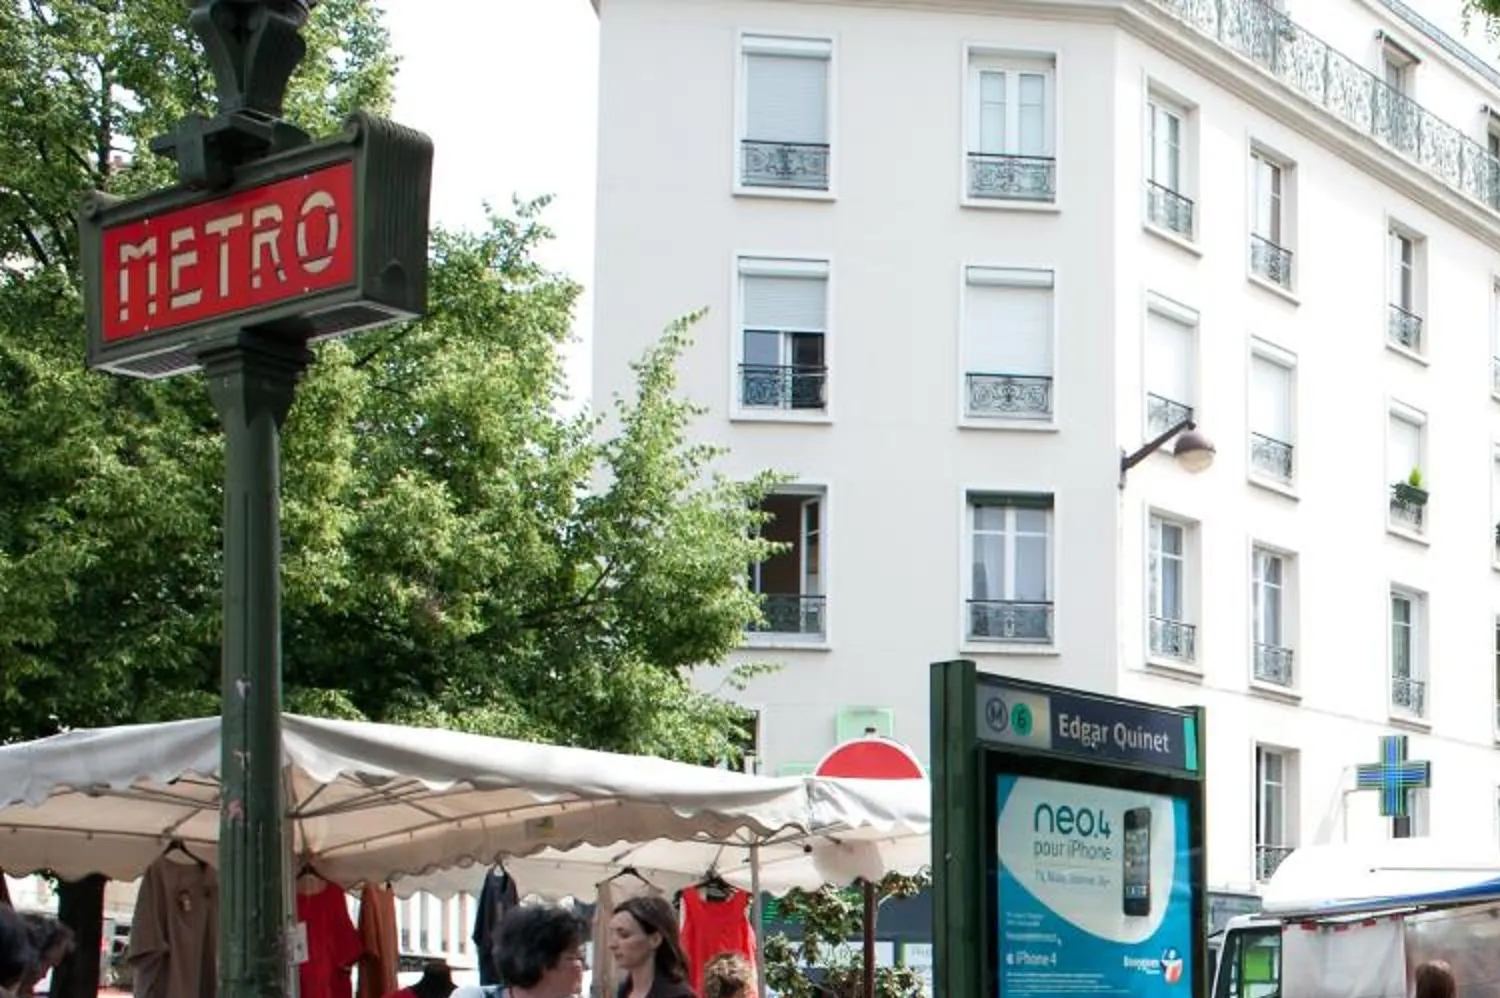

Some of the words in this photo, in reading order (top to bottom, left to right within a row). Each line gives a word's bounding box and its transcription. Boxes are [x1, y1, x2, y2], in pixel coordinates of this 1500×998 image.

[118, 190, 339, 322] METRO
[1058, 713, 1108, 747] Edgar
[1113, 722, 1170, 753] Quinet
[1034, 802, 1112, 839] neo.4
[1034, 841, 1065, 858] pour
[1067, 839, 1113, 860] iPhone
